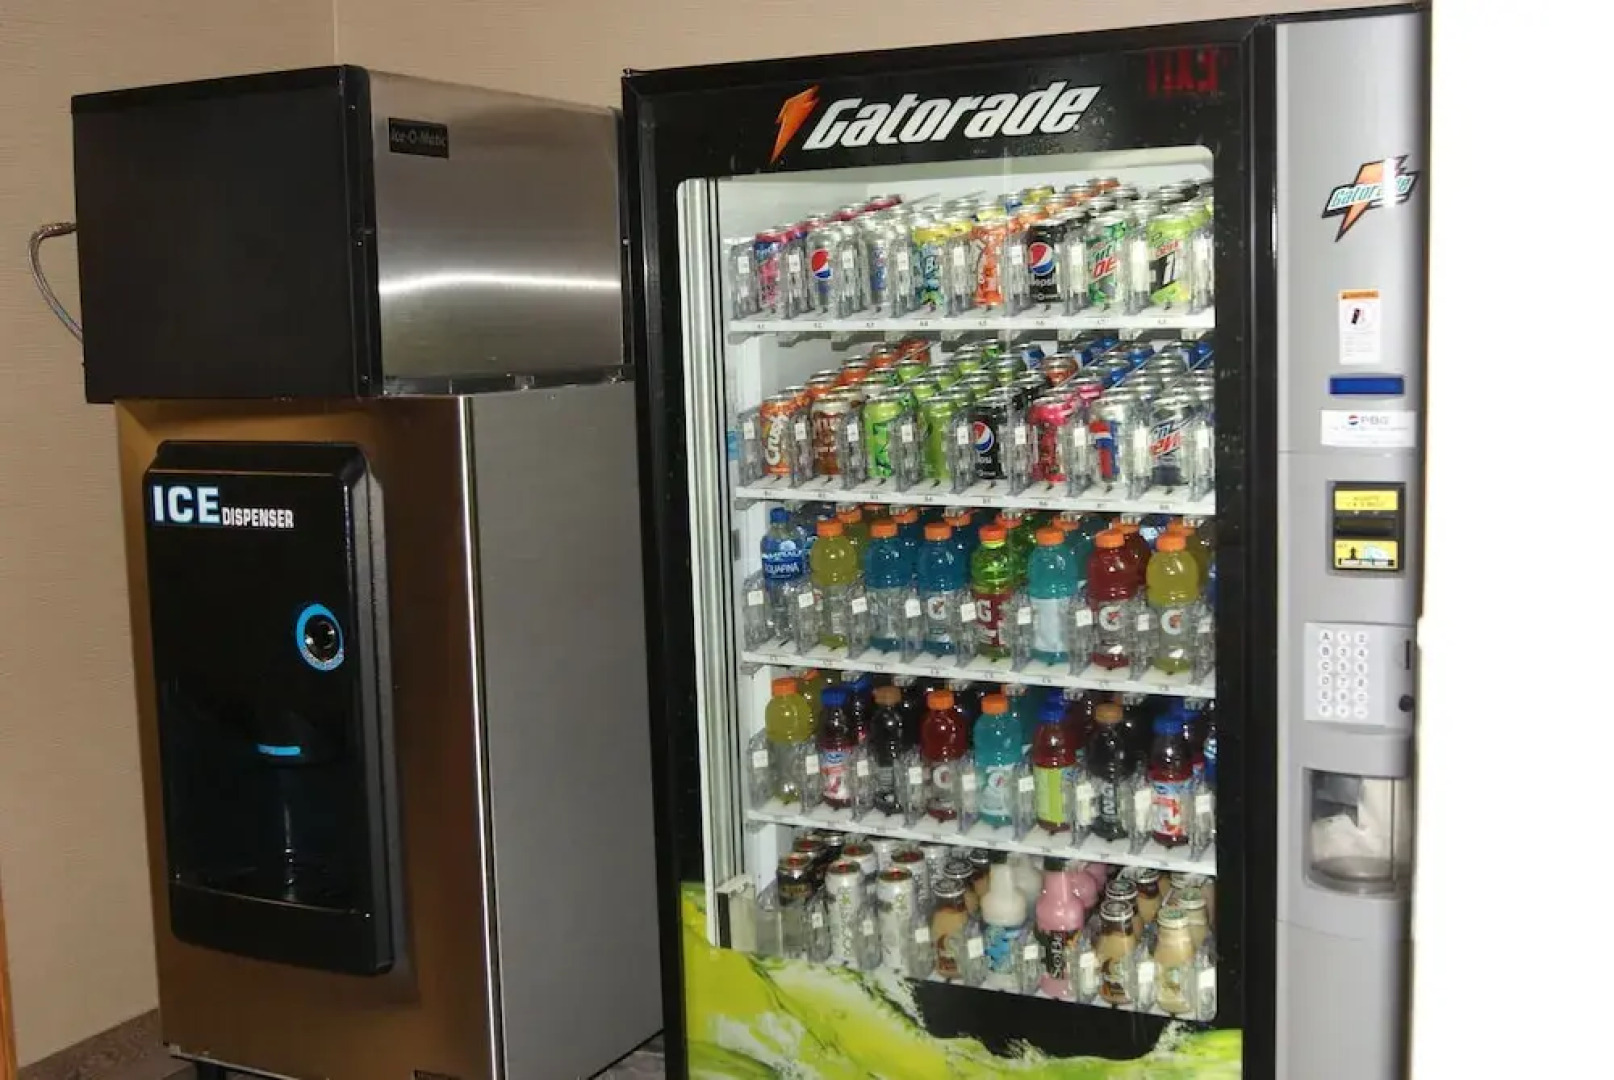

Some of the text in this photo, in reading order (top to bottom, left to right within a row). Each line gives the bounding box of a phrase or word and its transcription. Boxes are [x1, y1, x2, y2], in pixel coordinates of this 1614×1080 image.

[801, 81, 1100, 150] Gatorade
[152, 485, 295, 529] ICE DISPENSER
